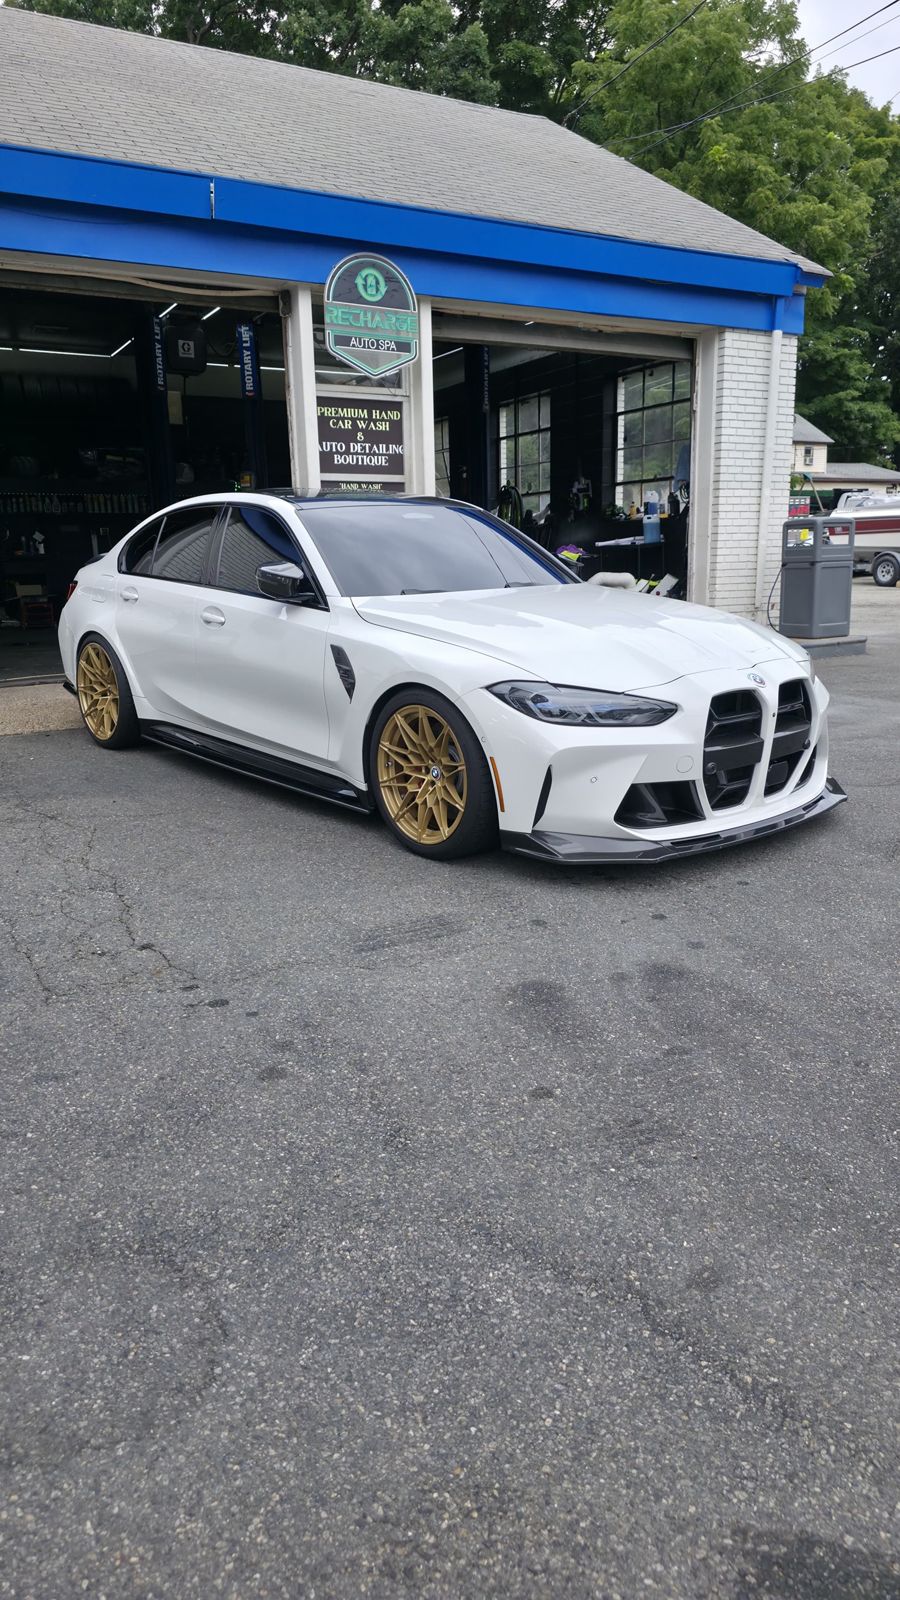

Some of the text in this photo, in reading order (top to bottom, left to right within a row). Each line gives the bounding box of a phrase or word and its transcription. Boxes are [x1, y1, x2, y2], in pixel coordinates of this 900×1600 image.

[325, 305, 418, 333] RECHARGE
[350, 337, 397, 351] AUTO SPA
[155, 342, 164, 385] ROTARY
[241, 325, 254, 390] ROTARY LIFT
[317, 406, 401, 420] PREMIUM HAND
[329, 419, 390, 431] CAR WASH
[356, 431, 364, 441] &
[334, 454, 389, 466] BOUTIQUE
